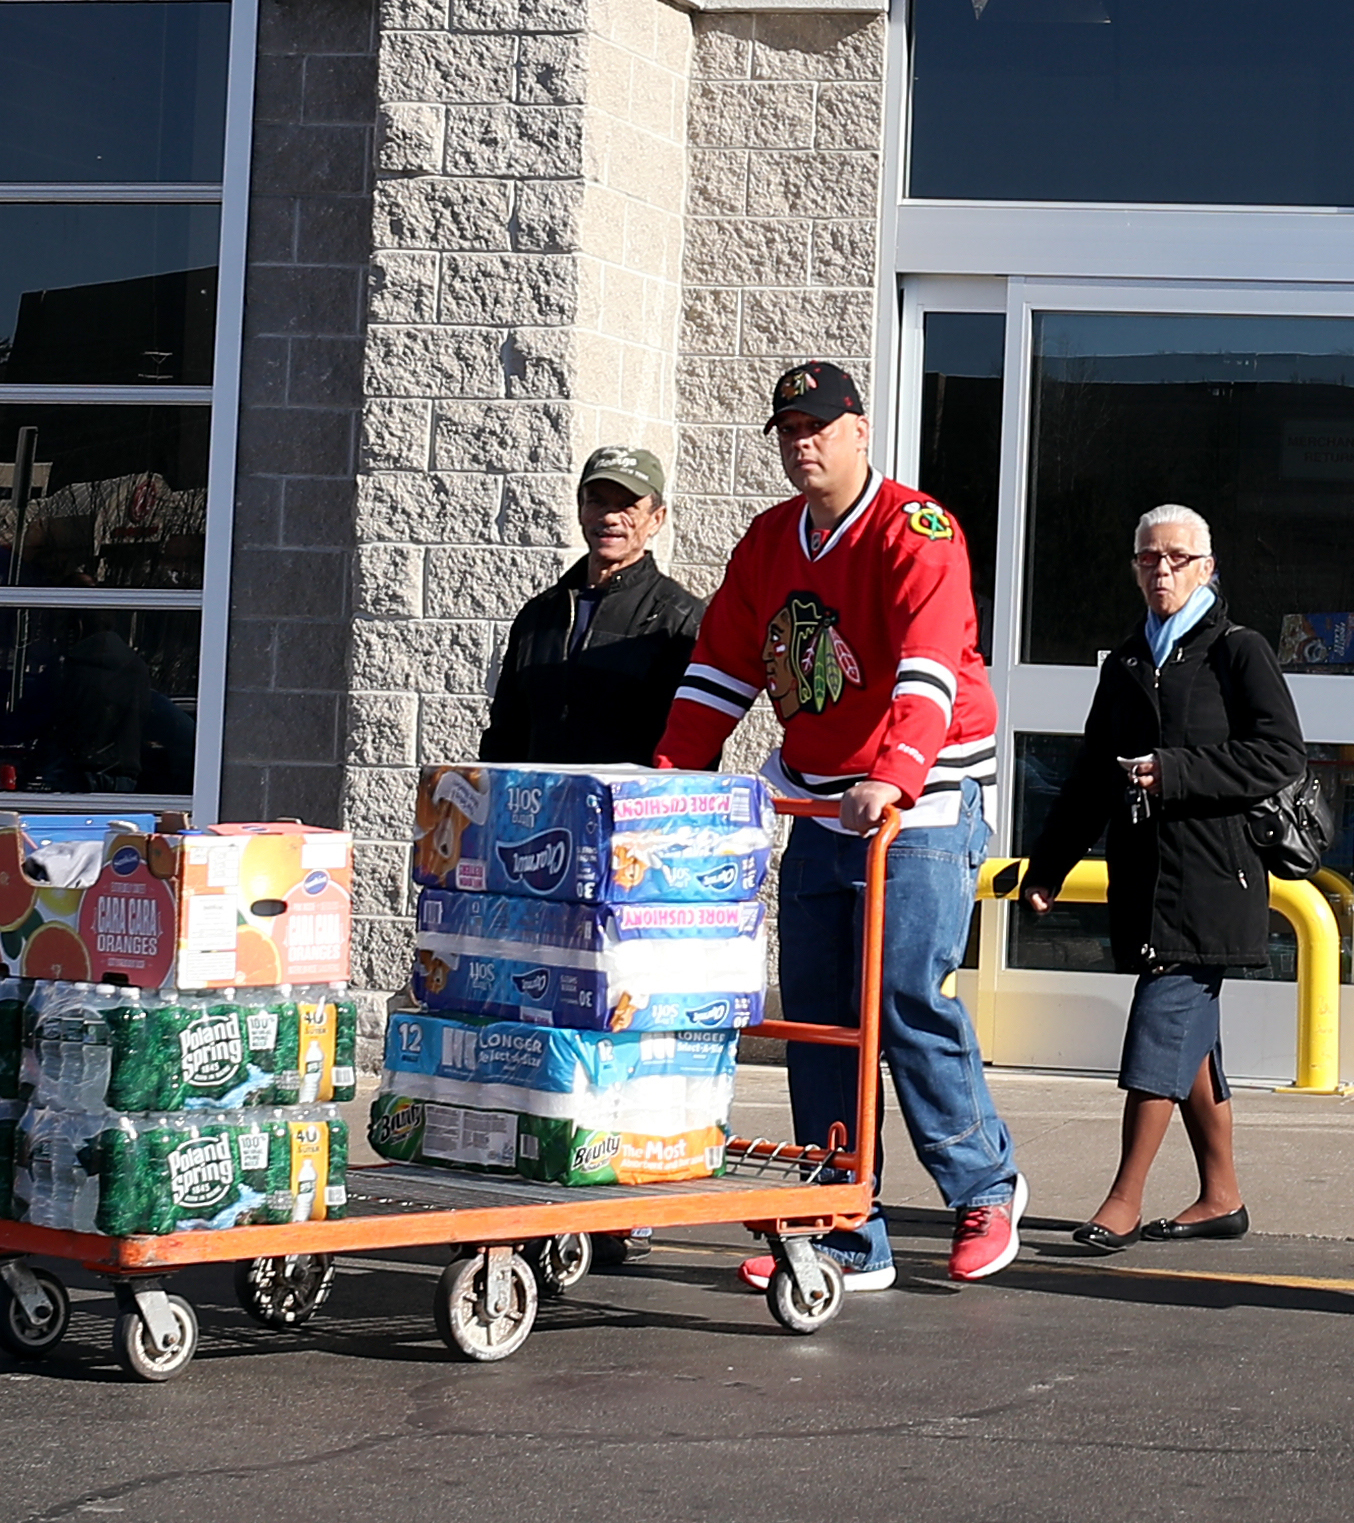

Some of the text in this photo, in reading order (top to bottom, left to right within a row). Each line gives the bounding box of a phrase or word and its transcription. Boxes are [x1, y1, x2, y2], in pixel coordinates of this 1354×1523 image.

[508, 787, 542, 814] Soft
[512, 813, 534, 828] Ultra
[513, 841, 565, 875] Charmin
[577, 881, 596, 899] 30
[98, 896, 126, 934] CARA
[128, 898, 157, 936] CARA
[624, 908, 739, 926] MORE CUSHIONY
[97, 934, 157, 955] ORANGES
[288, 944, 341, 962] ORANGES
[470, 961, 495, 981] Soft
[579, 990, 593, 1007] 30
[651, 1003, 680, 1017] Soft
[179, 1012, 241, 1057] Poland
[398, 1022, 422, 1052] 12
[479, 1030, 542, 1054] LONGER
[181, 1038, 242, 1082] Spring
[201, 1062, 220, 1075] 1845
[168, 1132, 231, 1179] Poland
[572, 1134, 621, 1168] Bounty
[622, 1138, 687, 1161] The Most
[171, 1159, 234, 1204] Spring
